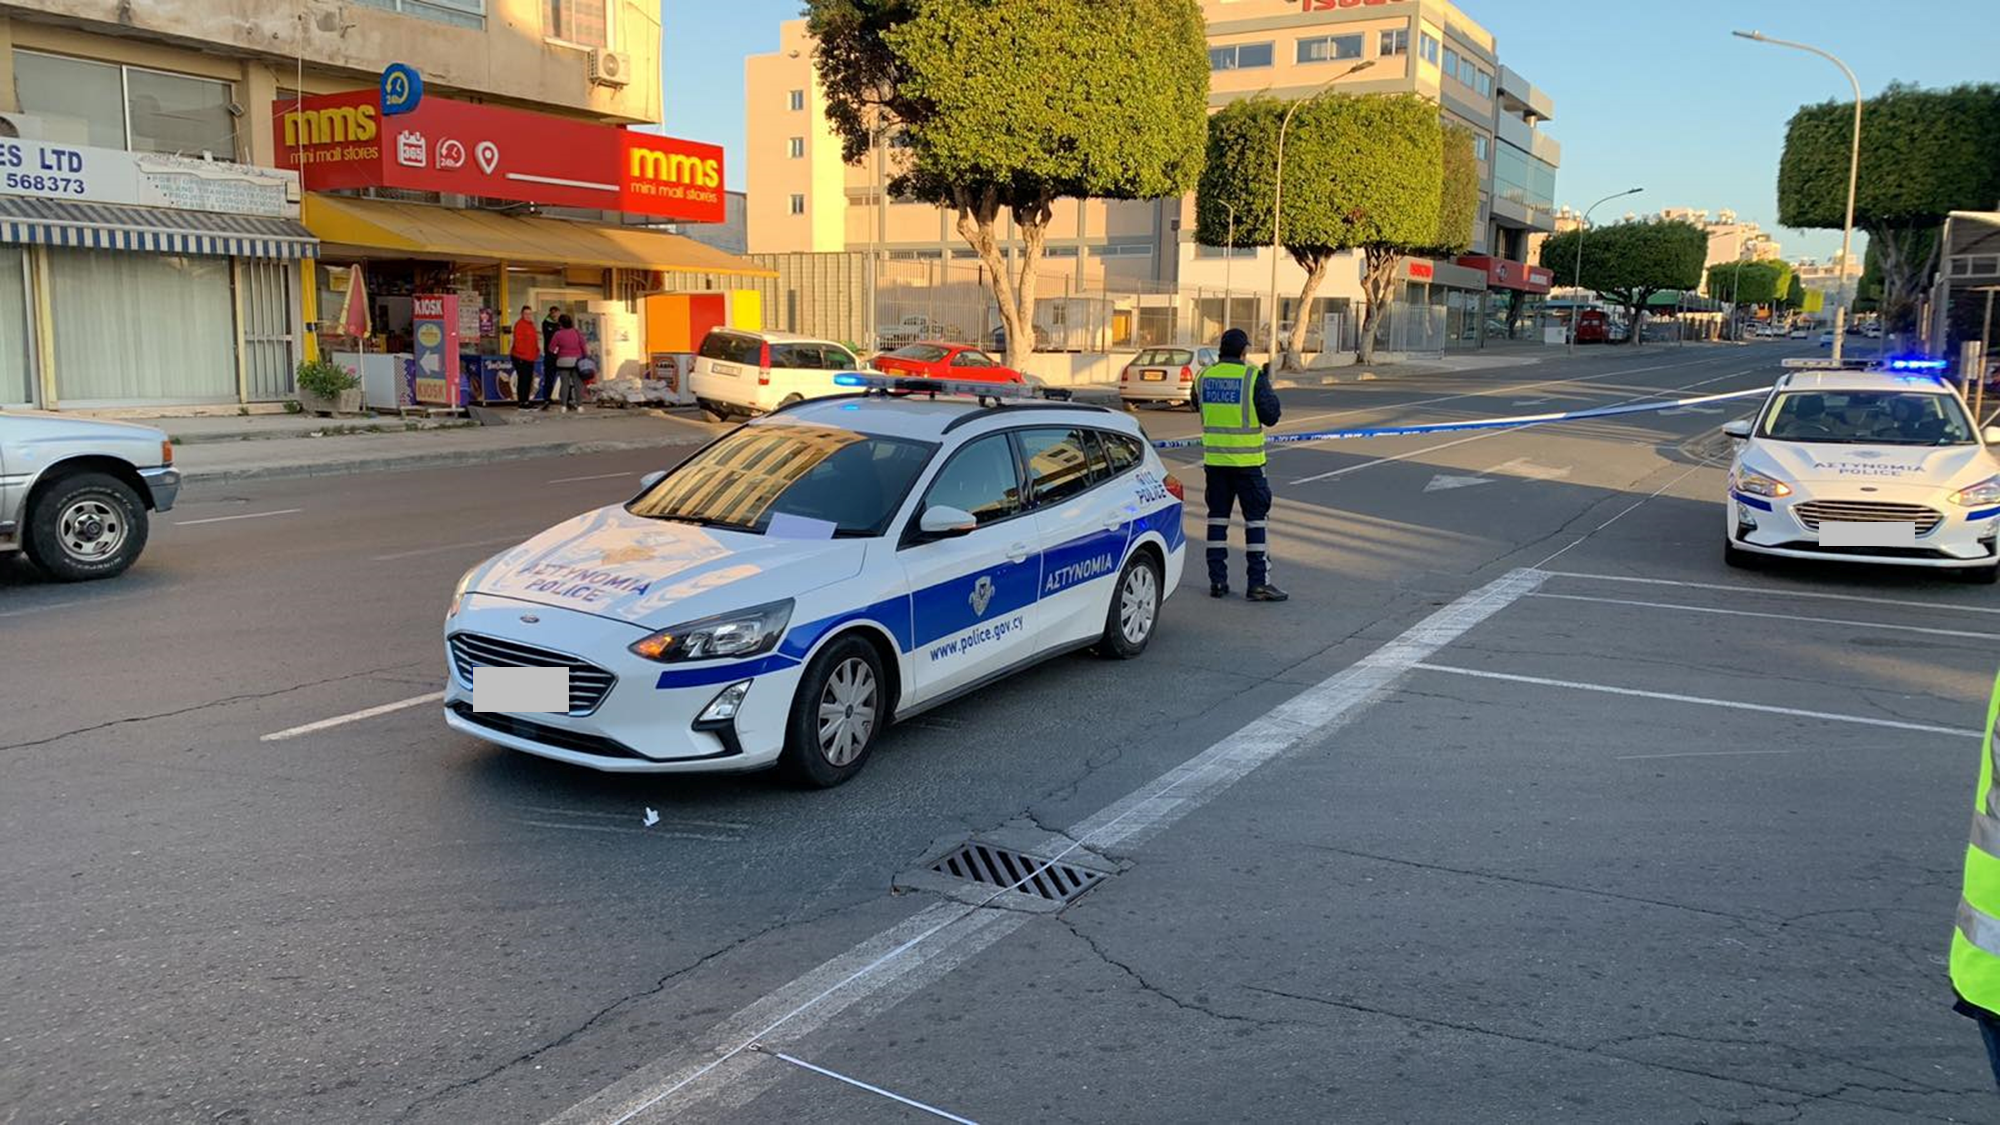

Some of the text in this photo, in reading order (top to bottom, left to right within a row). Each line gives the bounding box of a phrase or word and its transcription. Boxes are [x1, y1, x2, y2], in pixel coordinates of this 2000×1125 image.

[284, 104, 376, 146] mms
[39, 147, 83, 173] LTD
[316, 147, 341, 163] mall
[343, 145, 379, 161] stores
[630, 147, 720, 188] mms
[6, 172, 85, 194] 568373
[630, 182, 718, 203] mini mall stores
[414, 299, 443, 315] KIOSK
[1206, 390, 1236, 402] POLICE
[1813, 462, 1926, 472] ΑΣΤΥΝΟΜΙΑ
[518, 563, 652, 596] ΑΣΤΥΝΟΜΙΑ
[1045, 553, 1112, 592] ΑΣΤΥΝΟΜΙΑ
[525, 578, 604, 602] POLICE
[930, 615, 1024, 662] www.police.gov.cy
